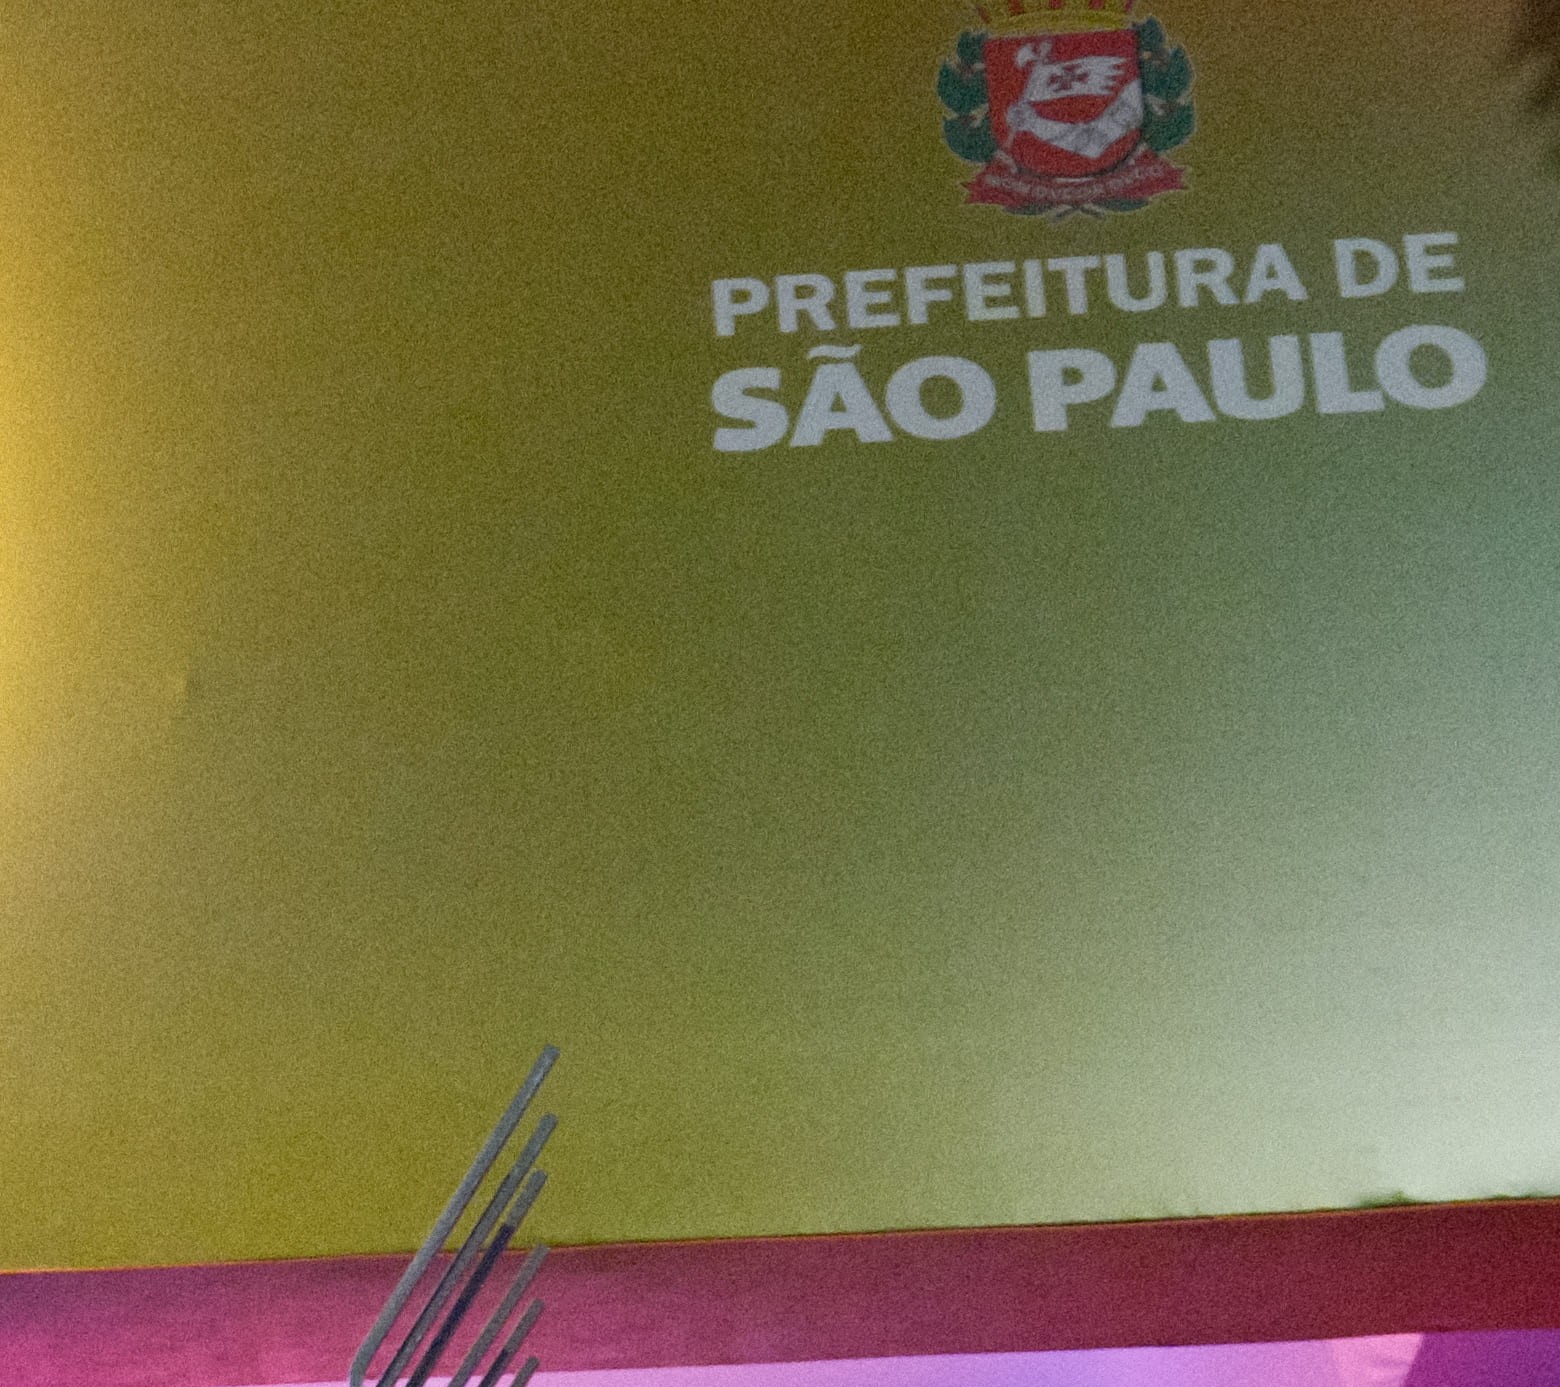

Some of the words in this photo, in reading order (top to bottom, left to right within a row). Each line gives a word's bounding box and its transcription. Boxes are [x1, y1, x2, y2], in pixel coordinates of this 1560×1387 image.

[711, 243, 1308, 337] PREFEITURA
[1333, 231, 1466, 299] DE
[711, 344, 998, 452] SÃO
[1027, 324, 1488, 433] PAULO
